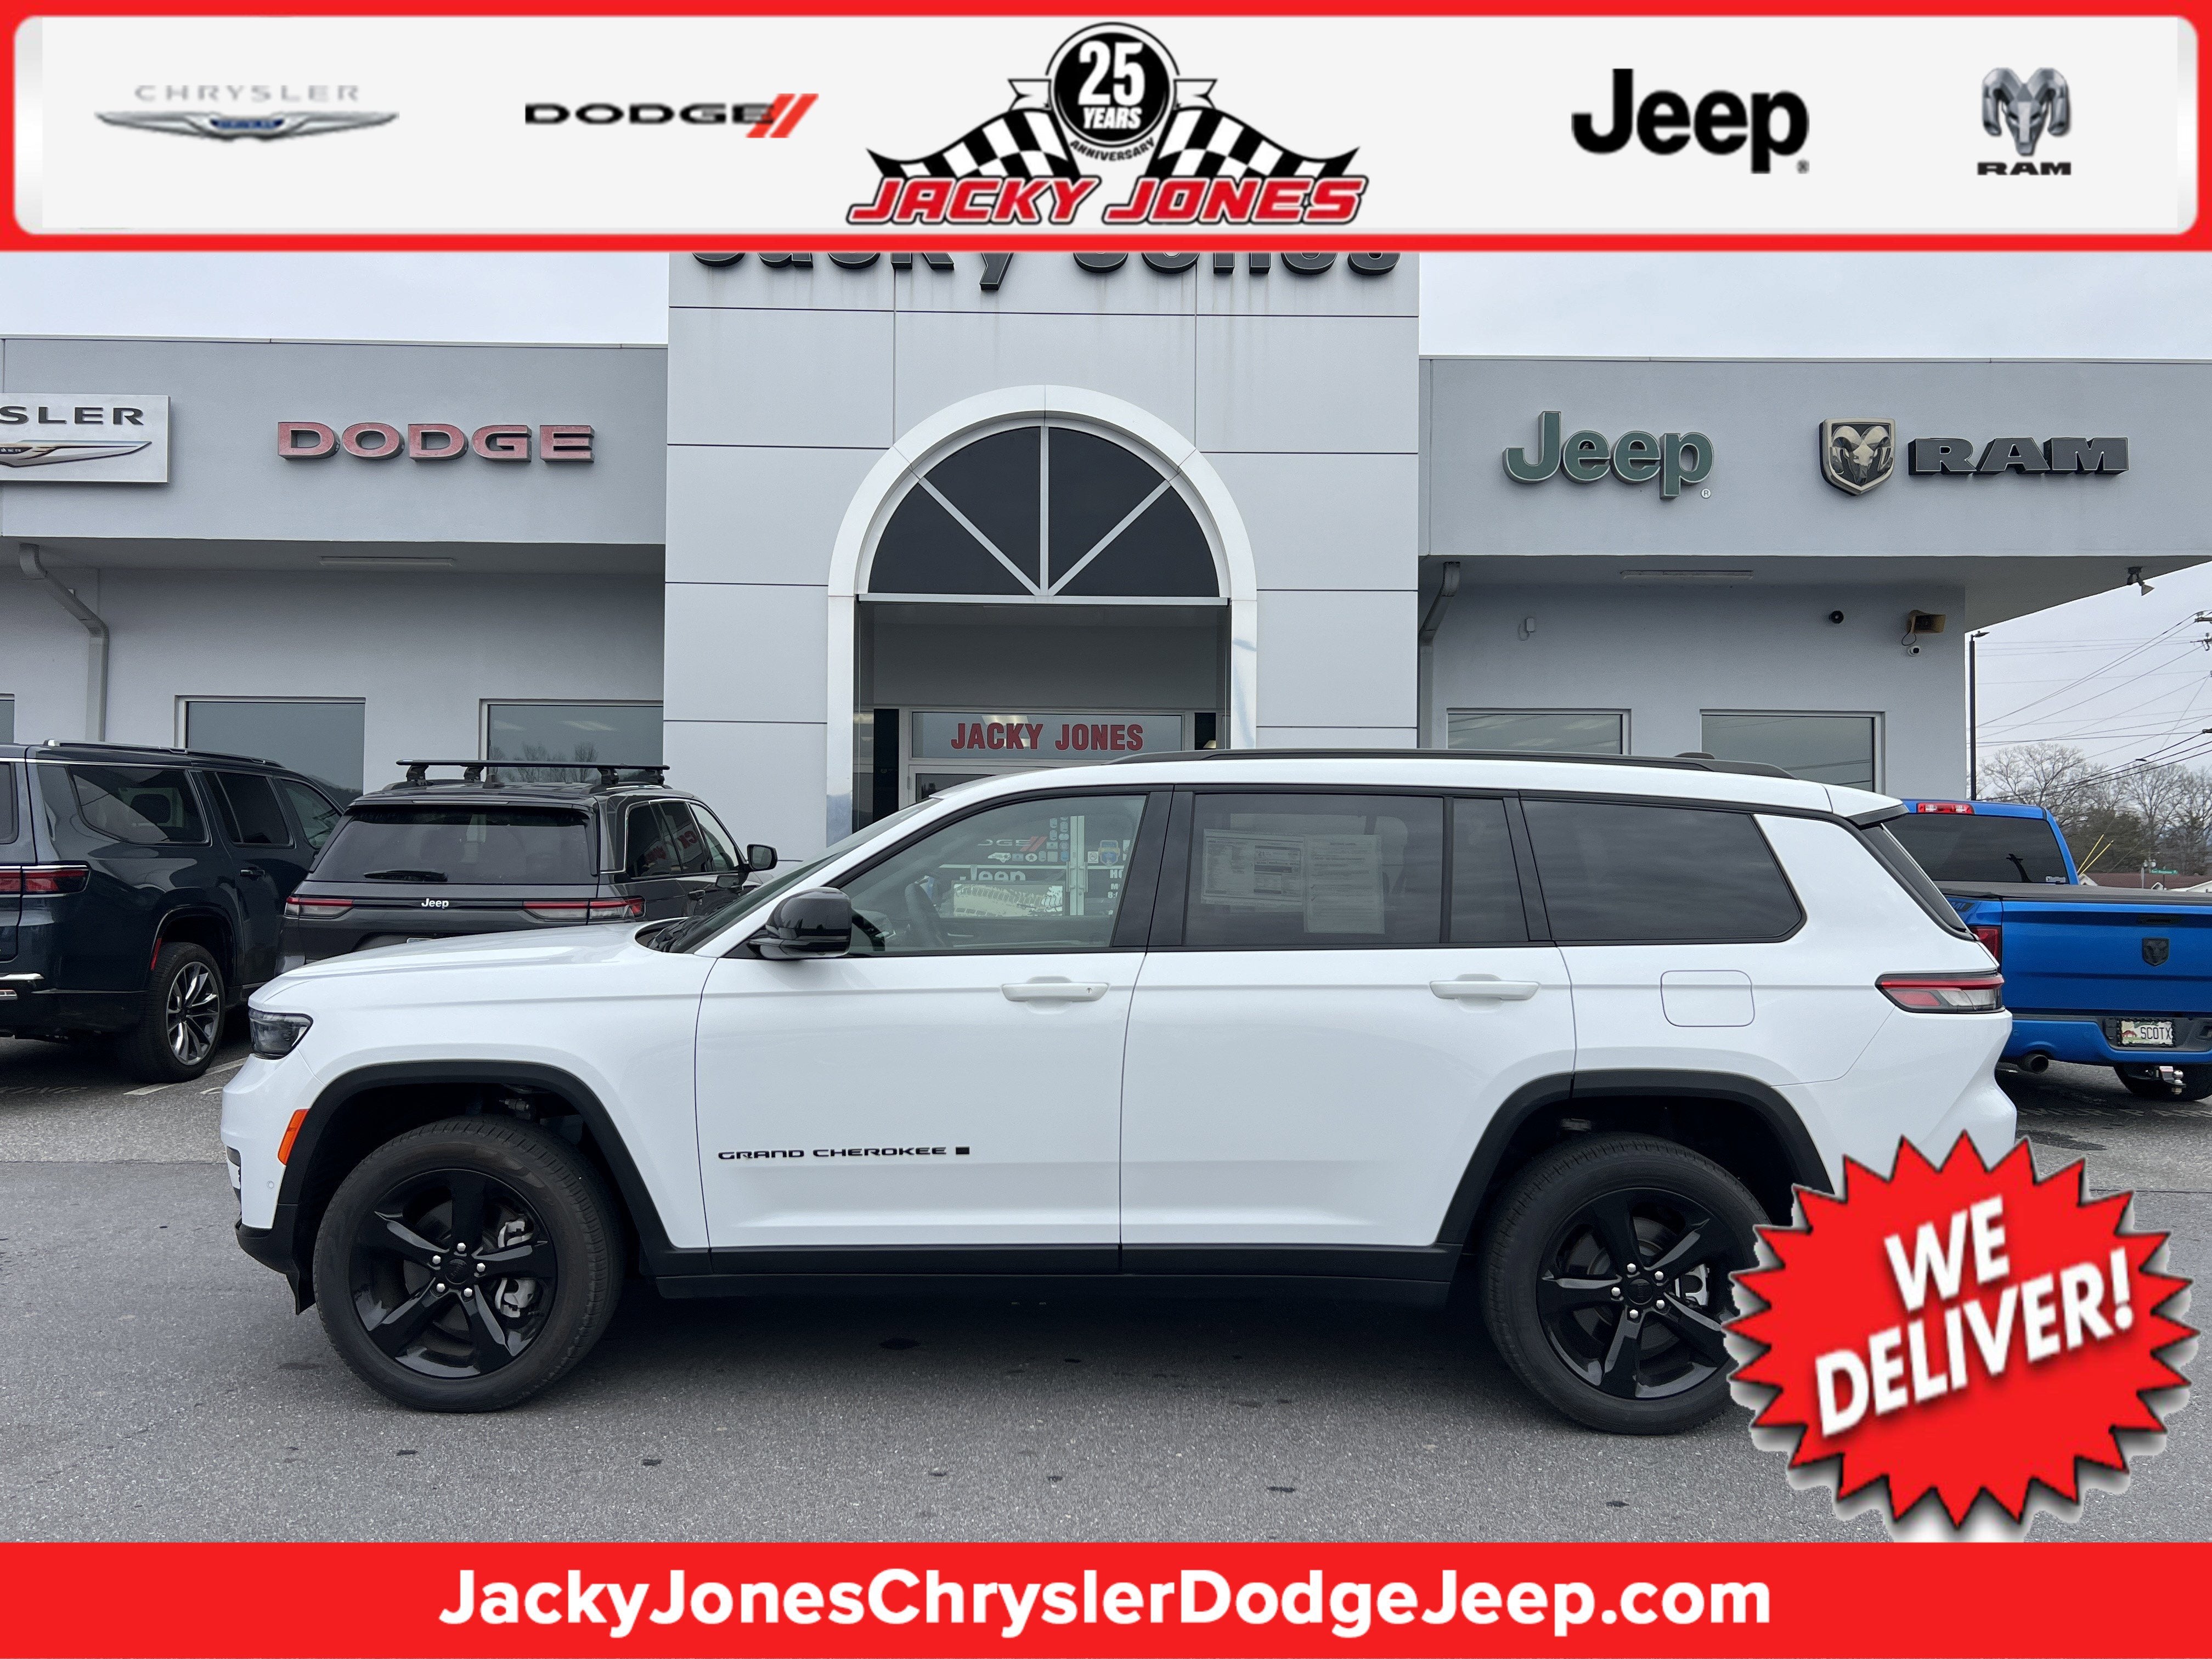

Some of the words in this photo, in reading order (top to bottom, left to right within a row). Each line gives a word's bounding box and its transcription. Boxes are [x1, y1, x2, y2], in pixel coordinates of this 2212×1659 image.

[0, 406, 144, 425] SLER
[278, 421, 595, 462] DODGE
[1503, 410, 1714, 499] Jeep
[1908, 437, 2129, 476] RAM
[950, 722, 1043, 750] JACKY
[1054, 724, 1144, 751] JONES
[421, 898, 449, 909] Jeep
[718, 1149, 804, 1160] GRAND
[812, 1146, 947, 1158] CHEROKEE
